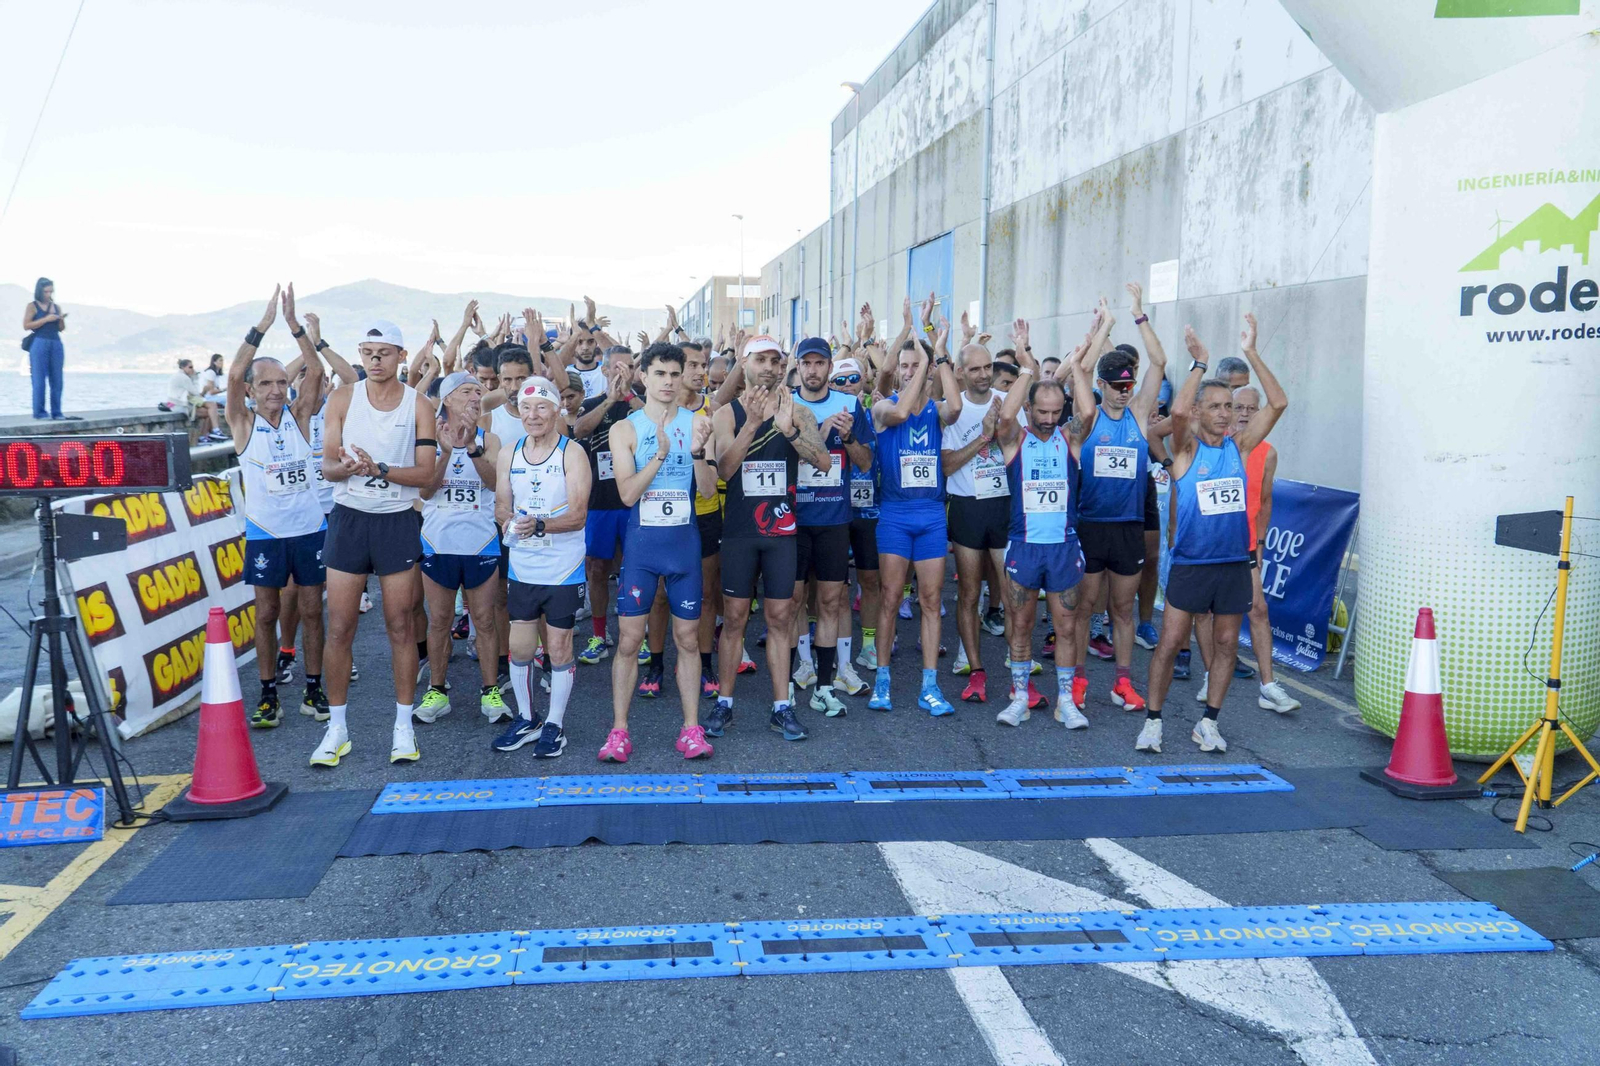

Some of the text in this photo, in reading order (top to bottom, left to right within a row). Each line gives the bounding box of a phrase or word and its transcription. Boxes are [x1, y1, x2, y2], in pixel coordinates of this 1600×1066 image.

[0, 440, 125, 487] 0:00
[1108, 456, 1128, 469] 34
[276, 469, 307, 485] 155
[756, 472, 776, 486] 11
[912, 465, 930, 478] 66
[992, 476, 1002, 488] 3
[444, 488, 476, 503] 153
[853, 489, 870, 500] 43
[1037, 490, 1058, 504] 70
[1209, 489, 1240, 505] 152
[662, 501, 674, 516] 6
[1265, 526, 1305, 563] oge
[137, 557, 201, 613] GADIS
[546, 784, 690, 796] CRONOTEC
[0, 788, 97, 826] TEC
[787, 921, 885, 933] CRONOTEC
[988, 915, 1082, 926] CRONOTEC
[576, 928, 677, 941] CRONOTEC
[1157, 925, 1333, 943] CRONOTEC
[1349, 920, 1520, 938] CRONOTEC
[122, 951, 236, 968] CRONOTEC
[290, 953, 503, 981] CRONOTEC
